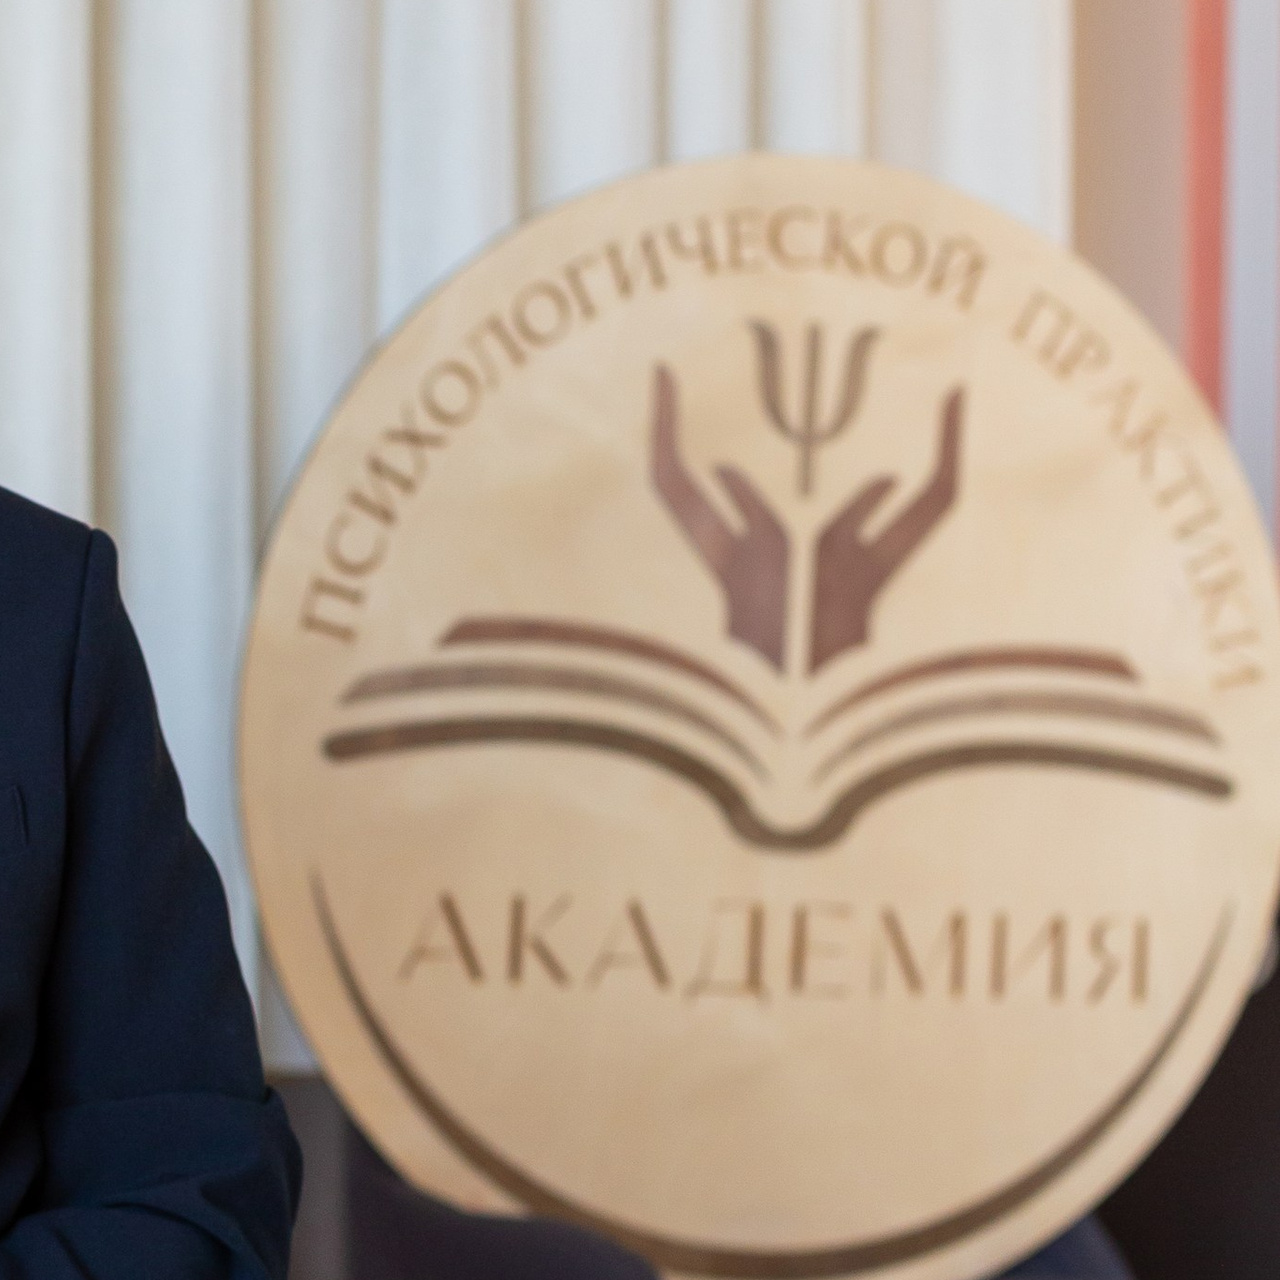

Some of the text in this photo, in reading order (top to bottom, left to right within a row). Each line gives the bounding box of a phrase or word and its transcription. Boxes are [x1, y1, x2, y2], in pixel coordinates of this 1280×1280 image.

[303, 207, 1263, 694] ПСИХОЛОГИЧЕСКОЙ ПРАКТИКИ
[398, 892, 1152, 1005] АКАДЕМИЯ
